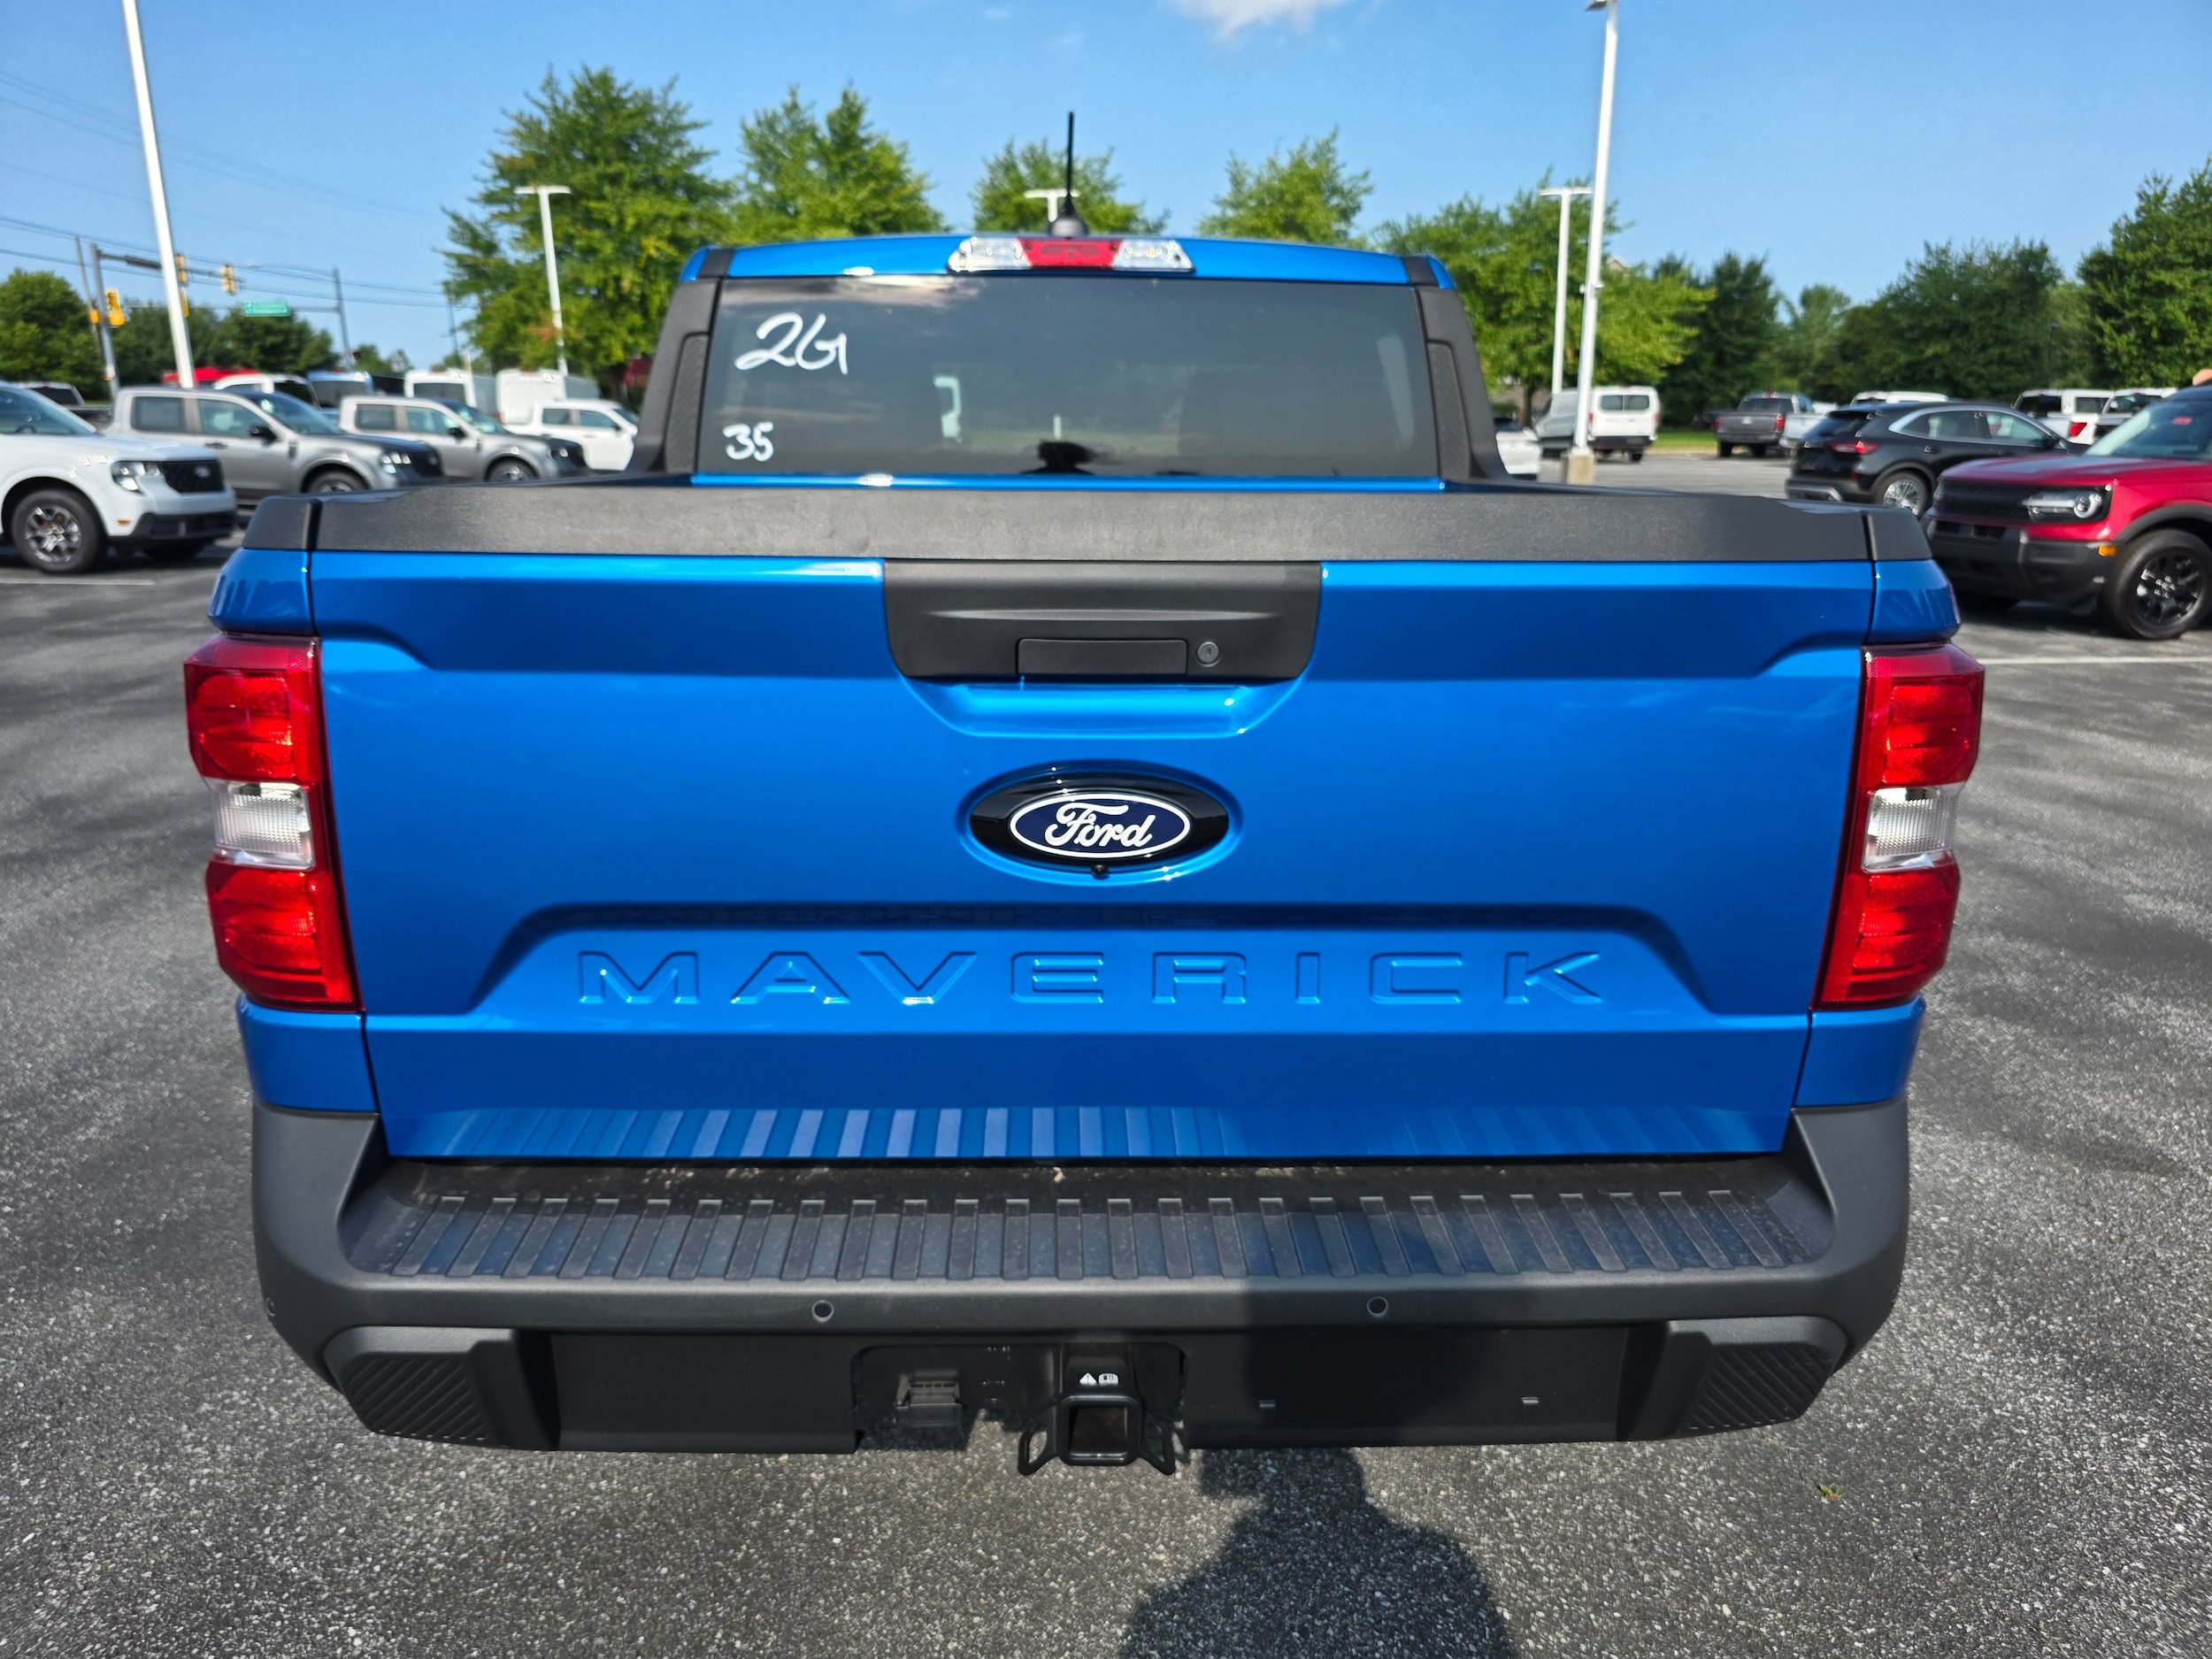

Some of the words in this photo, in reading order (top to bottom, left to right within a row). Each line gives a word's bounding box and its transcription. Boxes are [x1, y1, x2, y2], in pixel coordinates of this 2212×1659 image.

[723, 421, 774, 462] 35
[1045, 802, 1156, 848] Ford
[579, 951, 1602, 1004] MAVERICK
